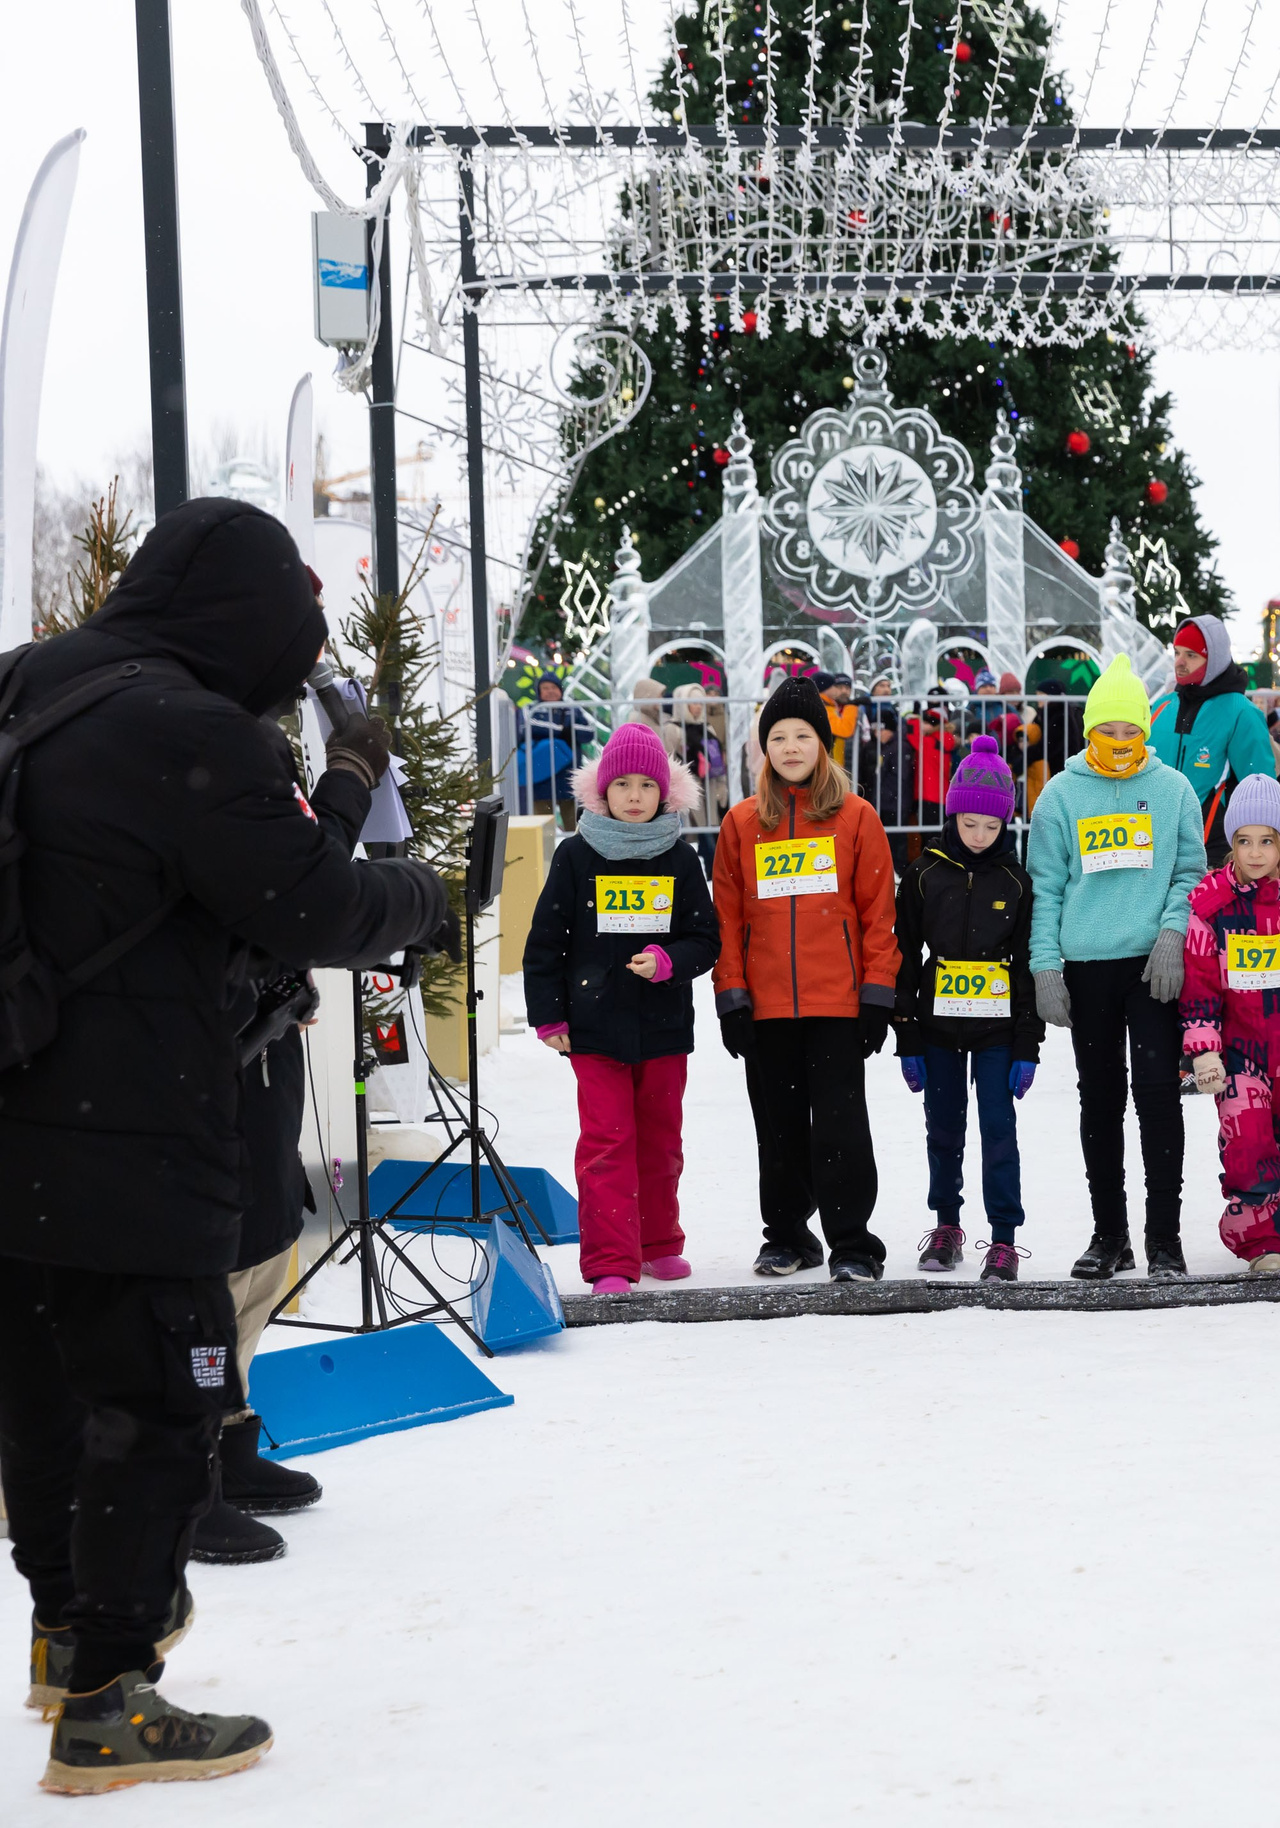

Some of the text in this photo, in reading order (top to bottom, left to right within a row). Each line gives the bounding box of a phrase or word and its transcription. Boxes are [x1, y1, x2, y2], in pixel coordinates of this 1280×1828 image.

[857, 420, 883, 439] 12
[820, 430, 841, 450] 11
[905, 430, 916, 450] 1
[788, 460, 815, 480] 10
[933, 459, 949, 478] 2
[784, 501, 799, 520] 9
[945, 498, 960, 518] 3
[795, 540, 811, 559] 8
[935, 538, 951, 558] 4
[826, 569, 841, 588] 7
[907, 569, 922, 587] 5
[1085, 826, 1128, 851] 220
[765, 852, 806, 876] 227
[604, 889, 645, 911] 213
[1235, 948, 1277, 968] 197
[940, 973, 986, 995] 209
